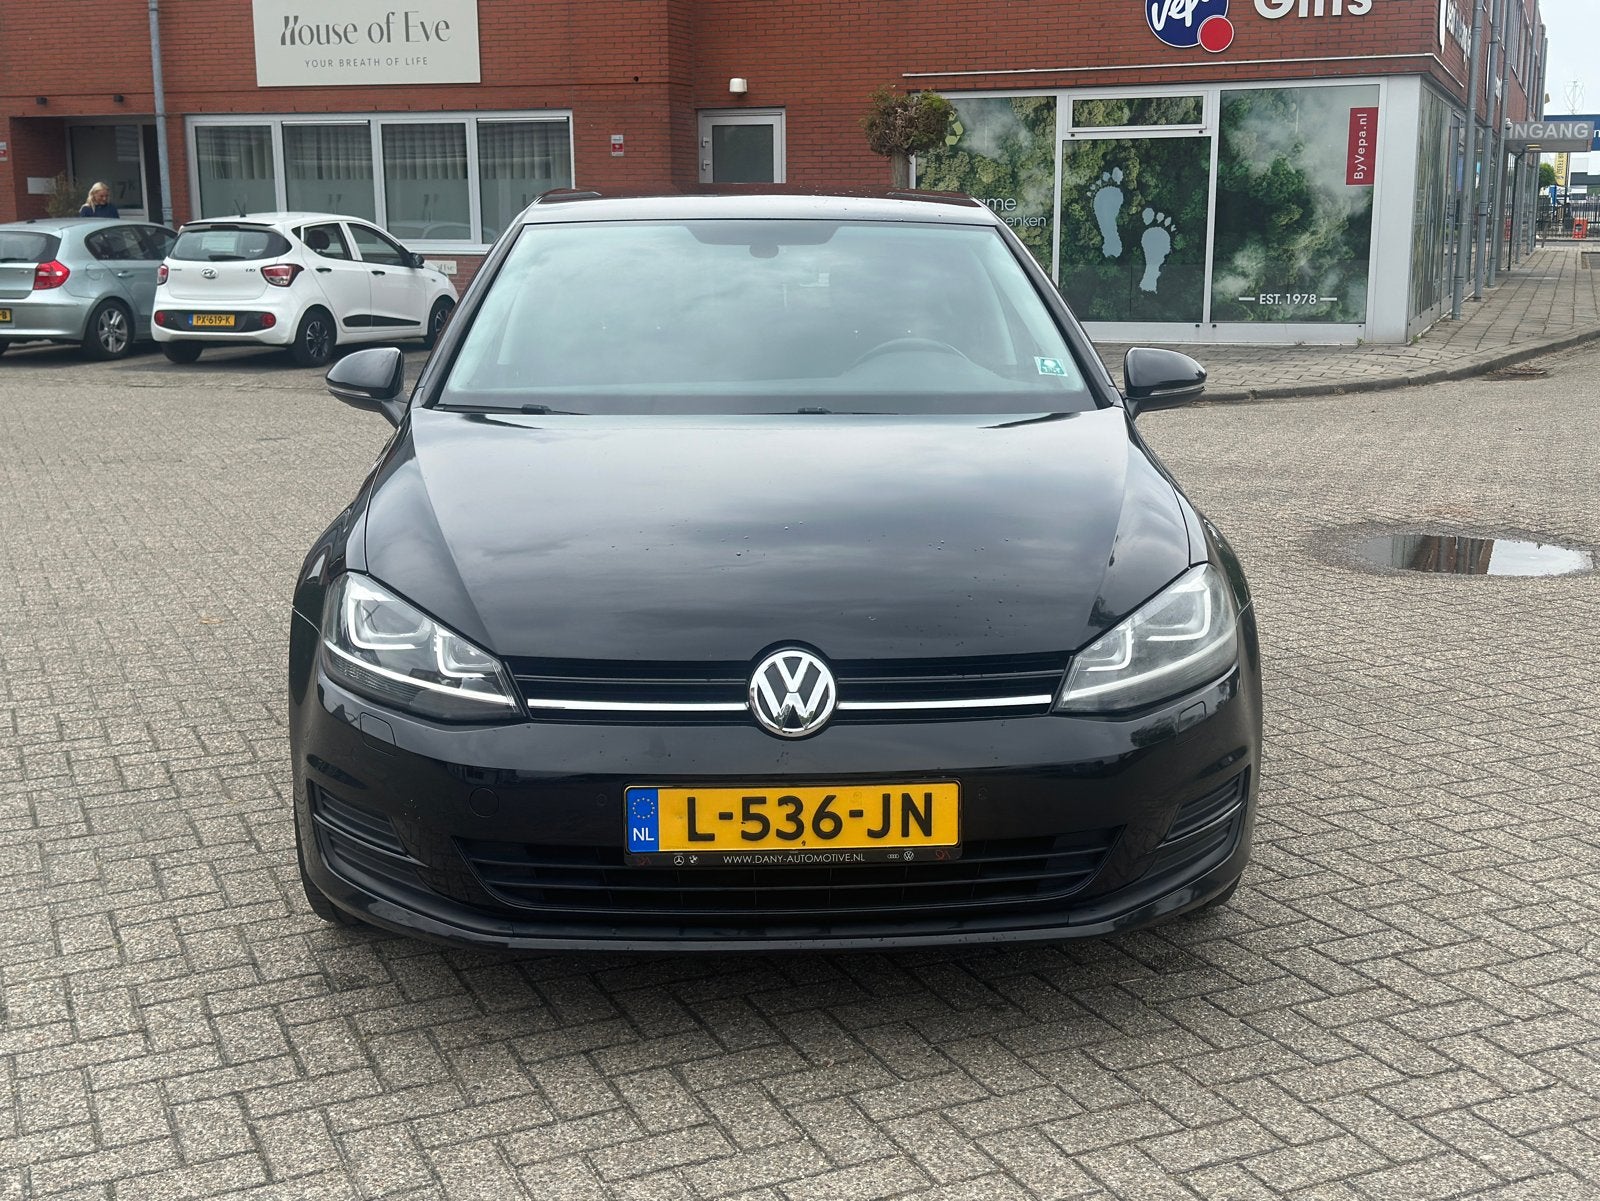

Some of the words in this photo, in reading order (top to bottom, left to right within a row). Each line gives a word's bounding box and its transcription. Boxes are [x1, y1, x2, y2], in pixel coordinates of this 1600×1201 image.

[280, 15, 358, 46] House
[367, 11, 395, 44] of
[404, 10, 451, 43] Eve
[304, 58, 334, 68] YOUR
[339, 57, 381, 67] BREATH
[386, 57, 400, 66] OF
[405, 56, 428, 66] LIFE
[1353, 113, 1368, 179] ByVepa.nl
[979, 197, 1017, 211] me
[1002, 215, 1047, 227] enken
[1259, 293, 1282, 305] EST.
[1286, 293, 1317, 305] 1978
[633, 827, 655, 842] NL
[687, 792, 933, 842] L-536-JN
[723, 853, 866, 864] WWW.DANY-AUTOMOTIVE.NL
